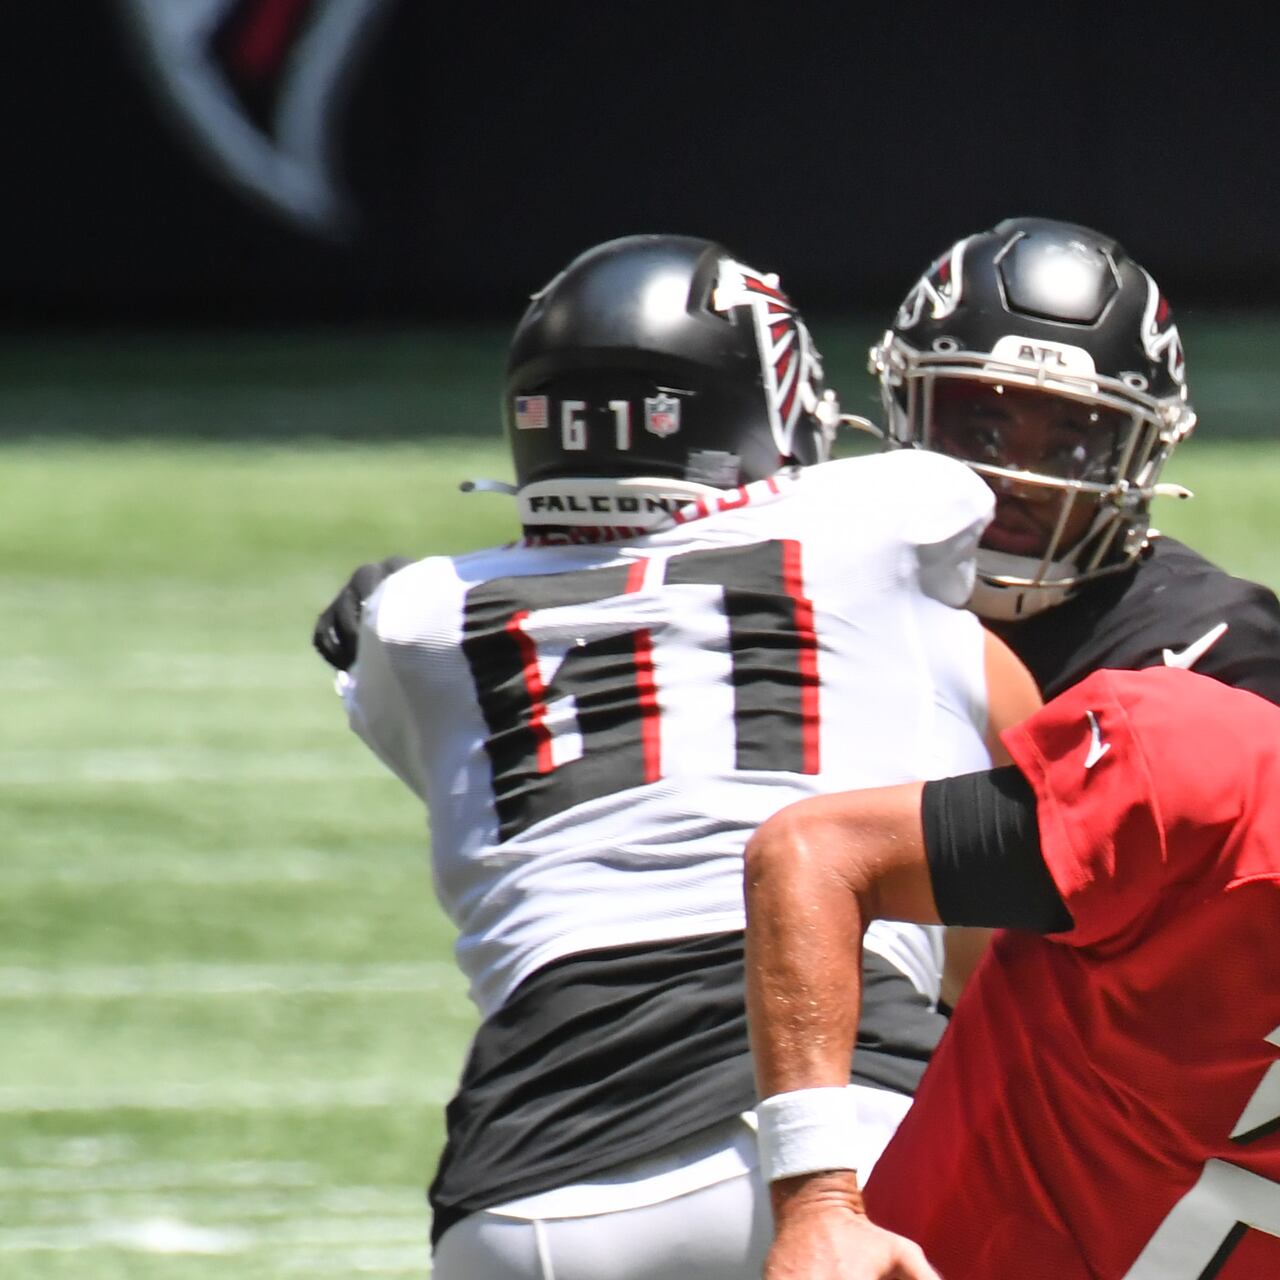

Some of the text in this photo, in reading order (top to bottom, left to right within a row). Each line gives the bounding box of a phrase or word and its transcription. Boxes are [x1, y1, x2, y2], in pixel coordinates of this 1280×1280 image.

[1017, 345, 1067, 367] ATL
[561, 400, 632, 450] 61
[530, 495, 677, 513] FALCON
[462, 540, 821, 843] 61
